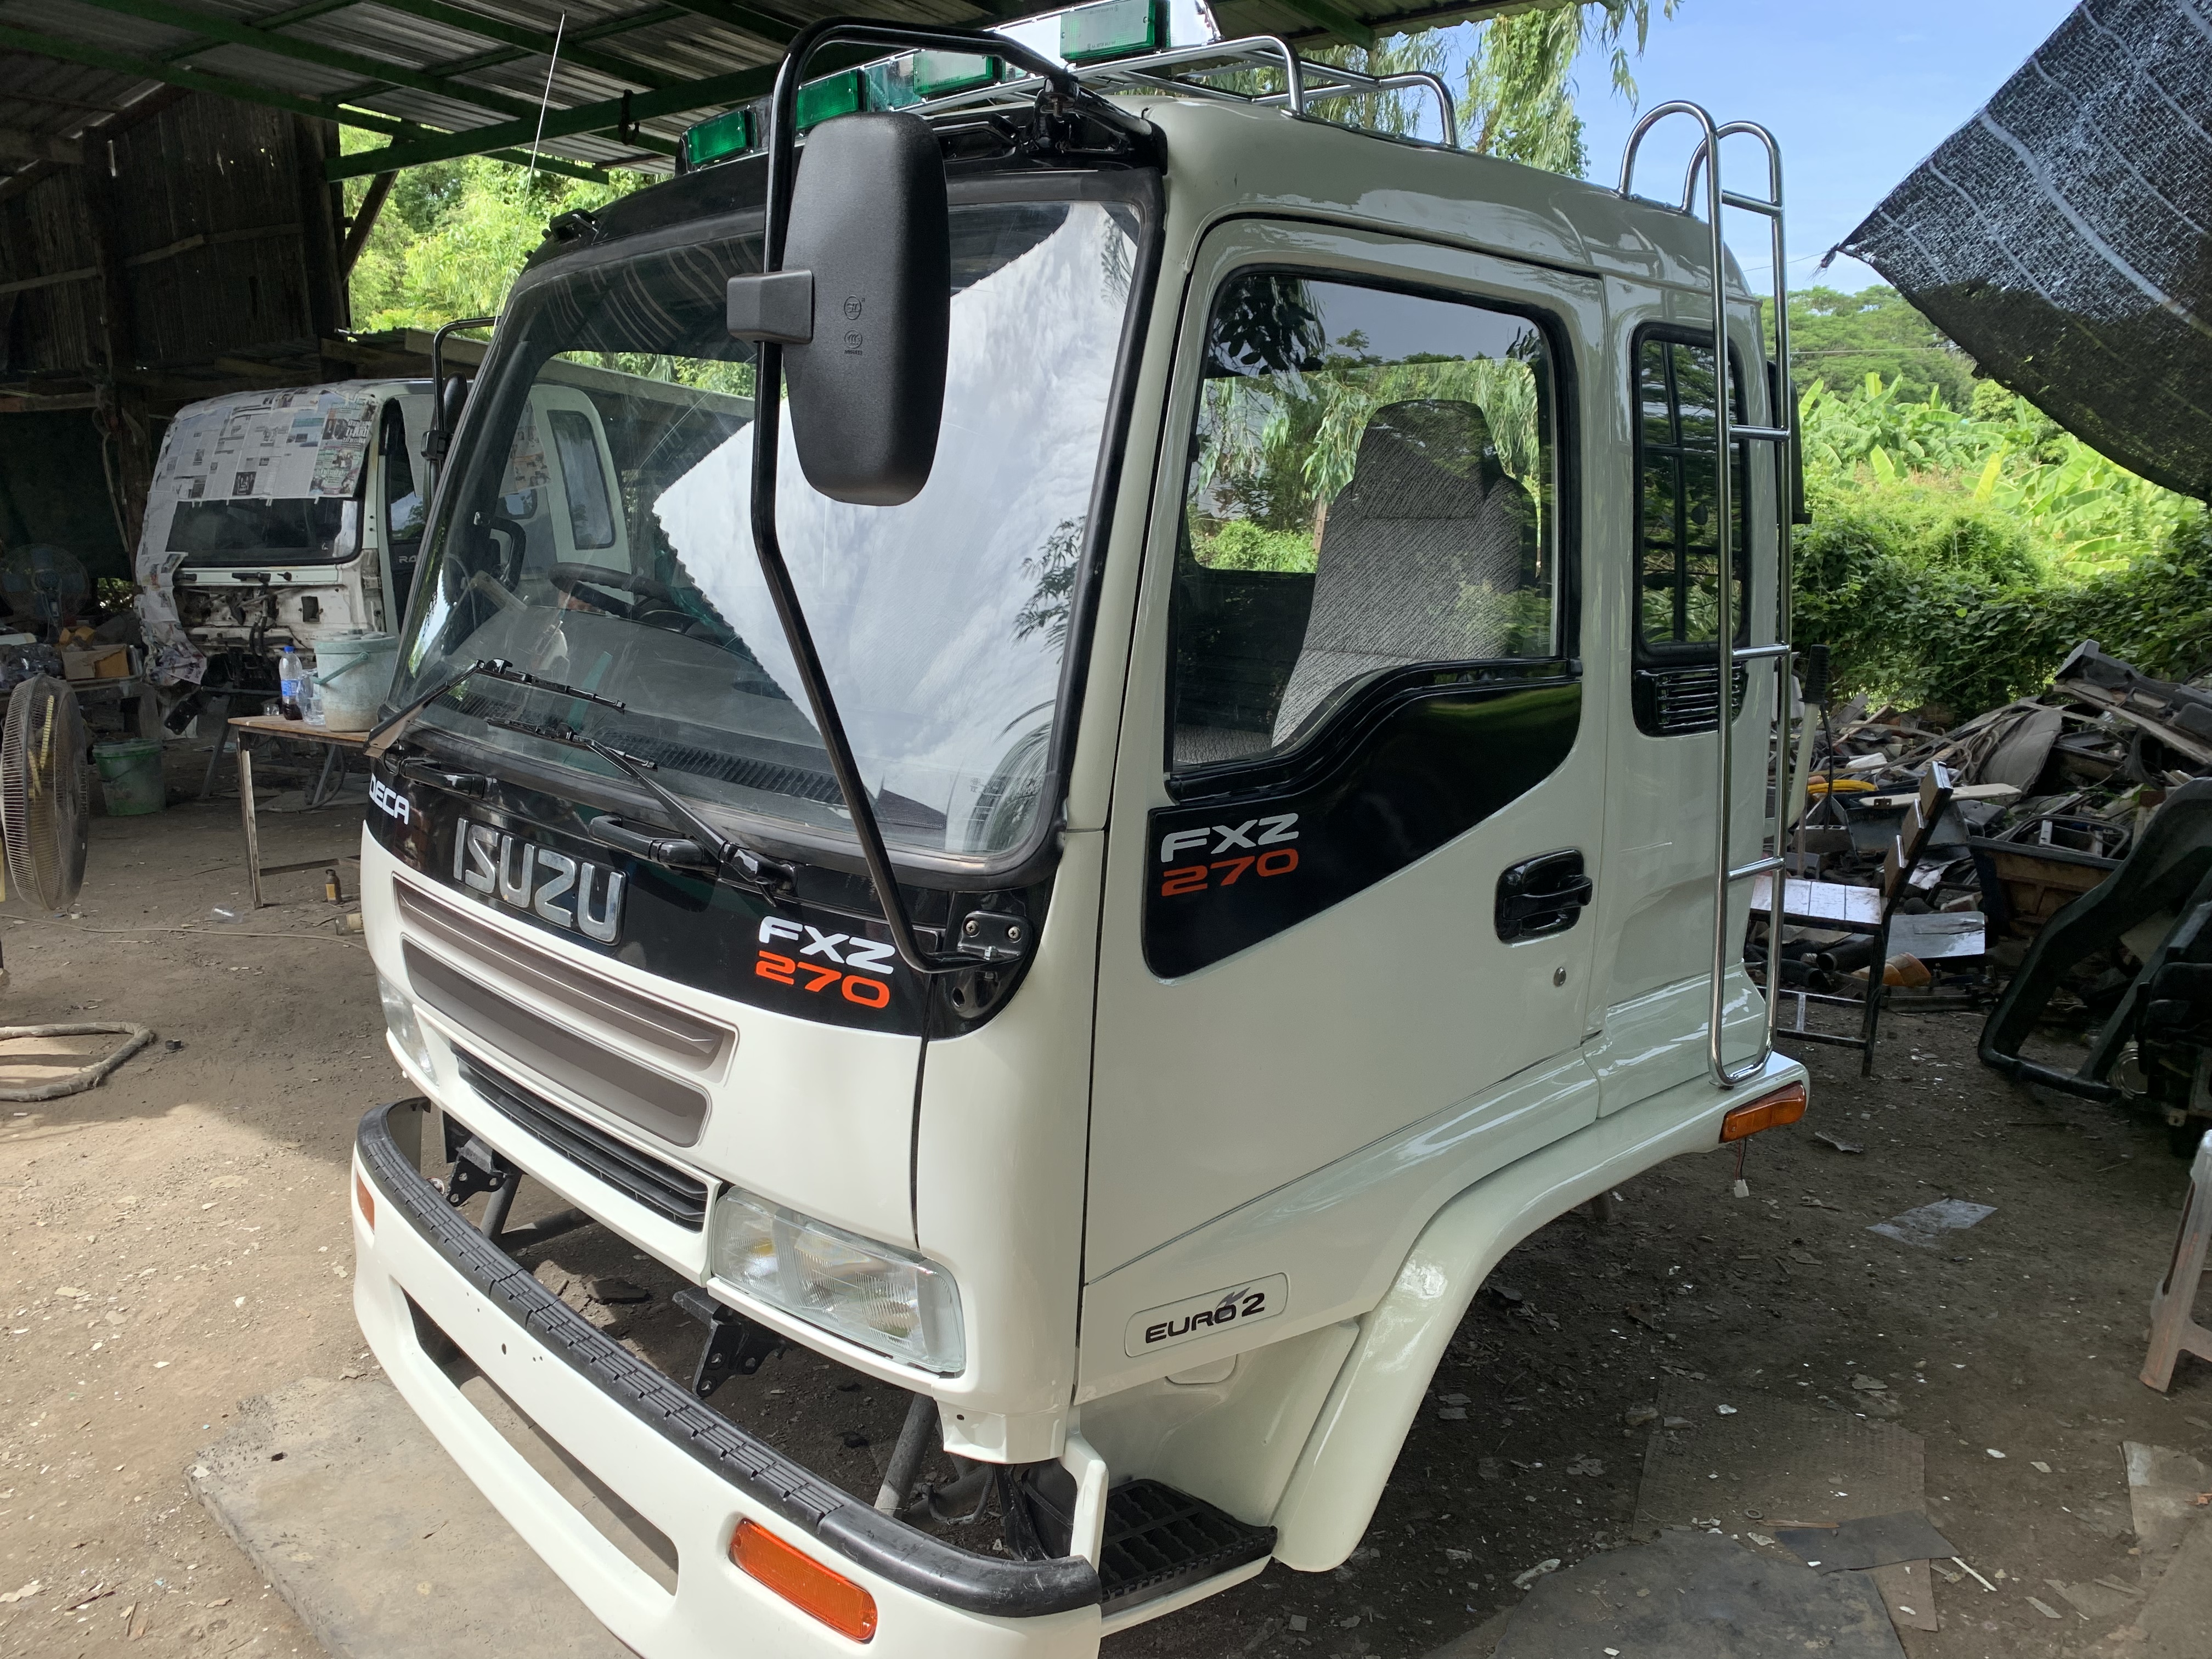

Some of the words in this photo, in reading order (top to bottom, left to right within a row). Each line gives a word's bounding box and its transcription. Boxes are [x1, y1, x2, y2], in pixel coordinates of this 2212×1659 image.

[398, 555, 419, 564] RA
[369, 772, 410, 825] DECA
[1160, 812, 1300, 863] FXZ
[454, 817, 627, 945] ISUZU
[1161, 848, 1299, 897] 270
[759, 916, 896, 974] FXZ
[755, 950, 890, 1009] 270
[1145, 1304, 1237, 1344] EURO
[1241, 1292, 1265, 1317] 2
